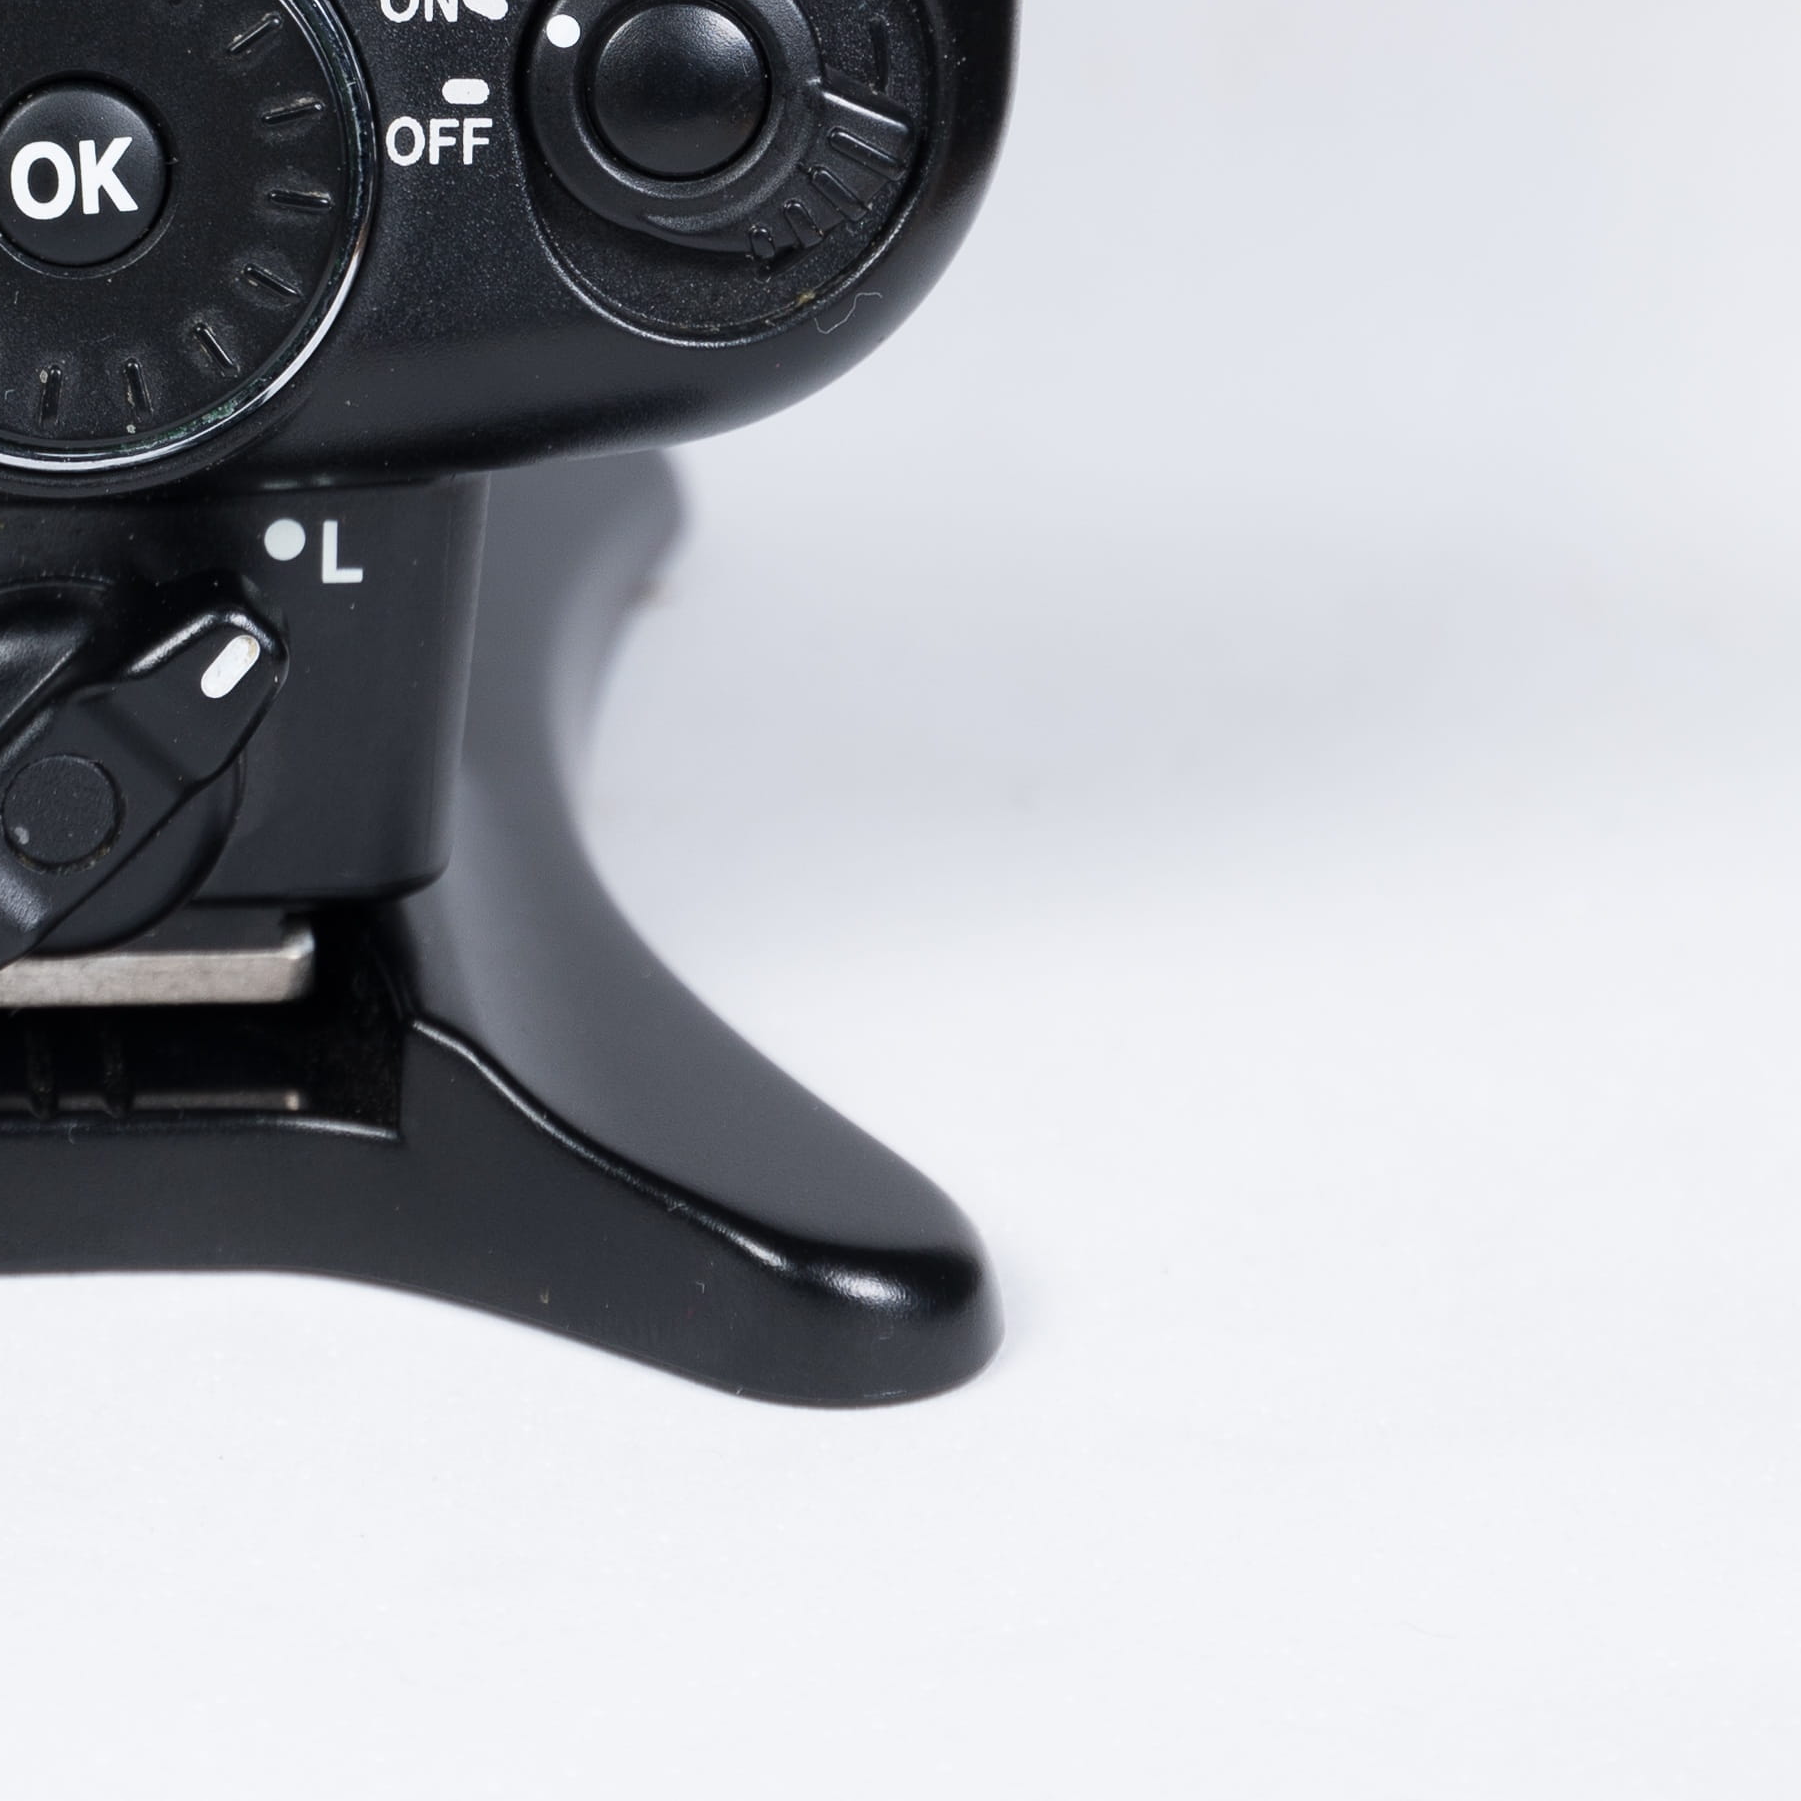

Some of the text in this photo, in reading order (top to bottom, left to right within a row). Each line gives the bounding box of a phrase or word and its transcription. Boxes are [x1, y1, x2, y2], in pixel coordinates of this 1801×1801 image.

[385, 117, 494, 167] OFF
[9, 136, 139, 221] OK
[321, 519, 365, 585] L
